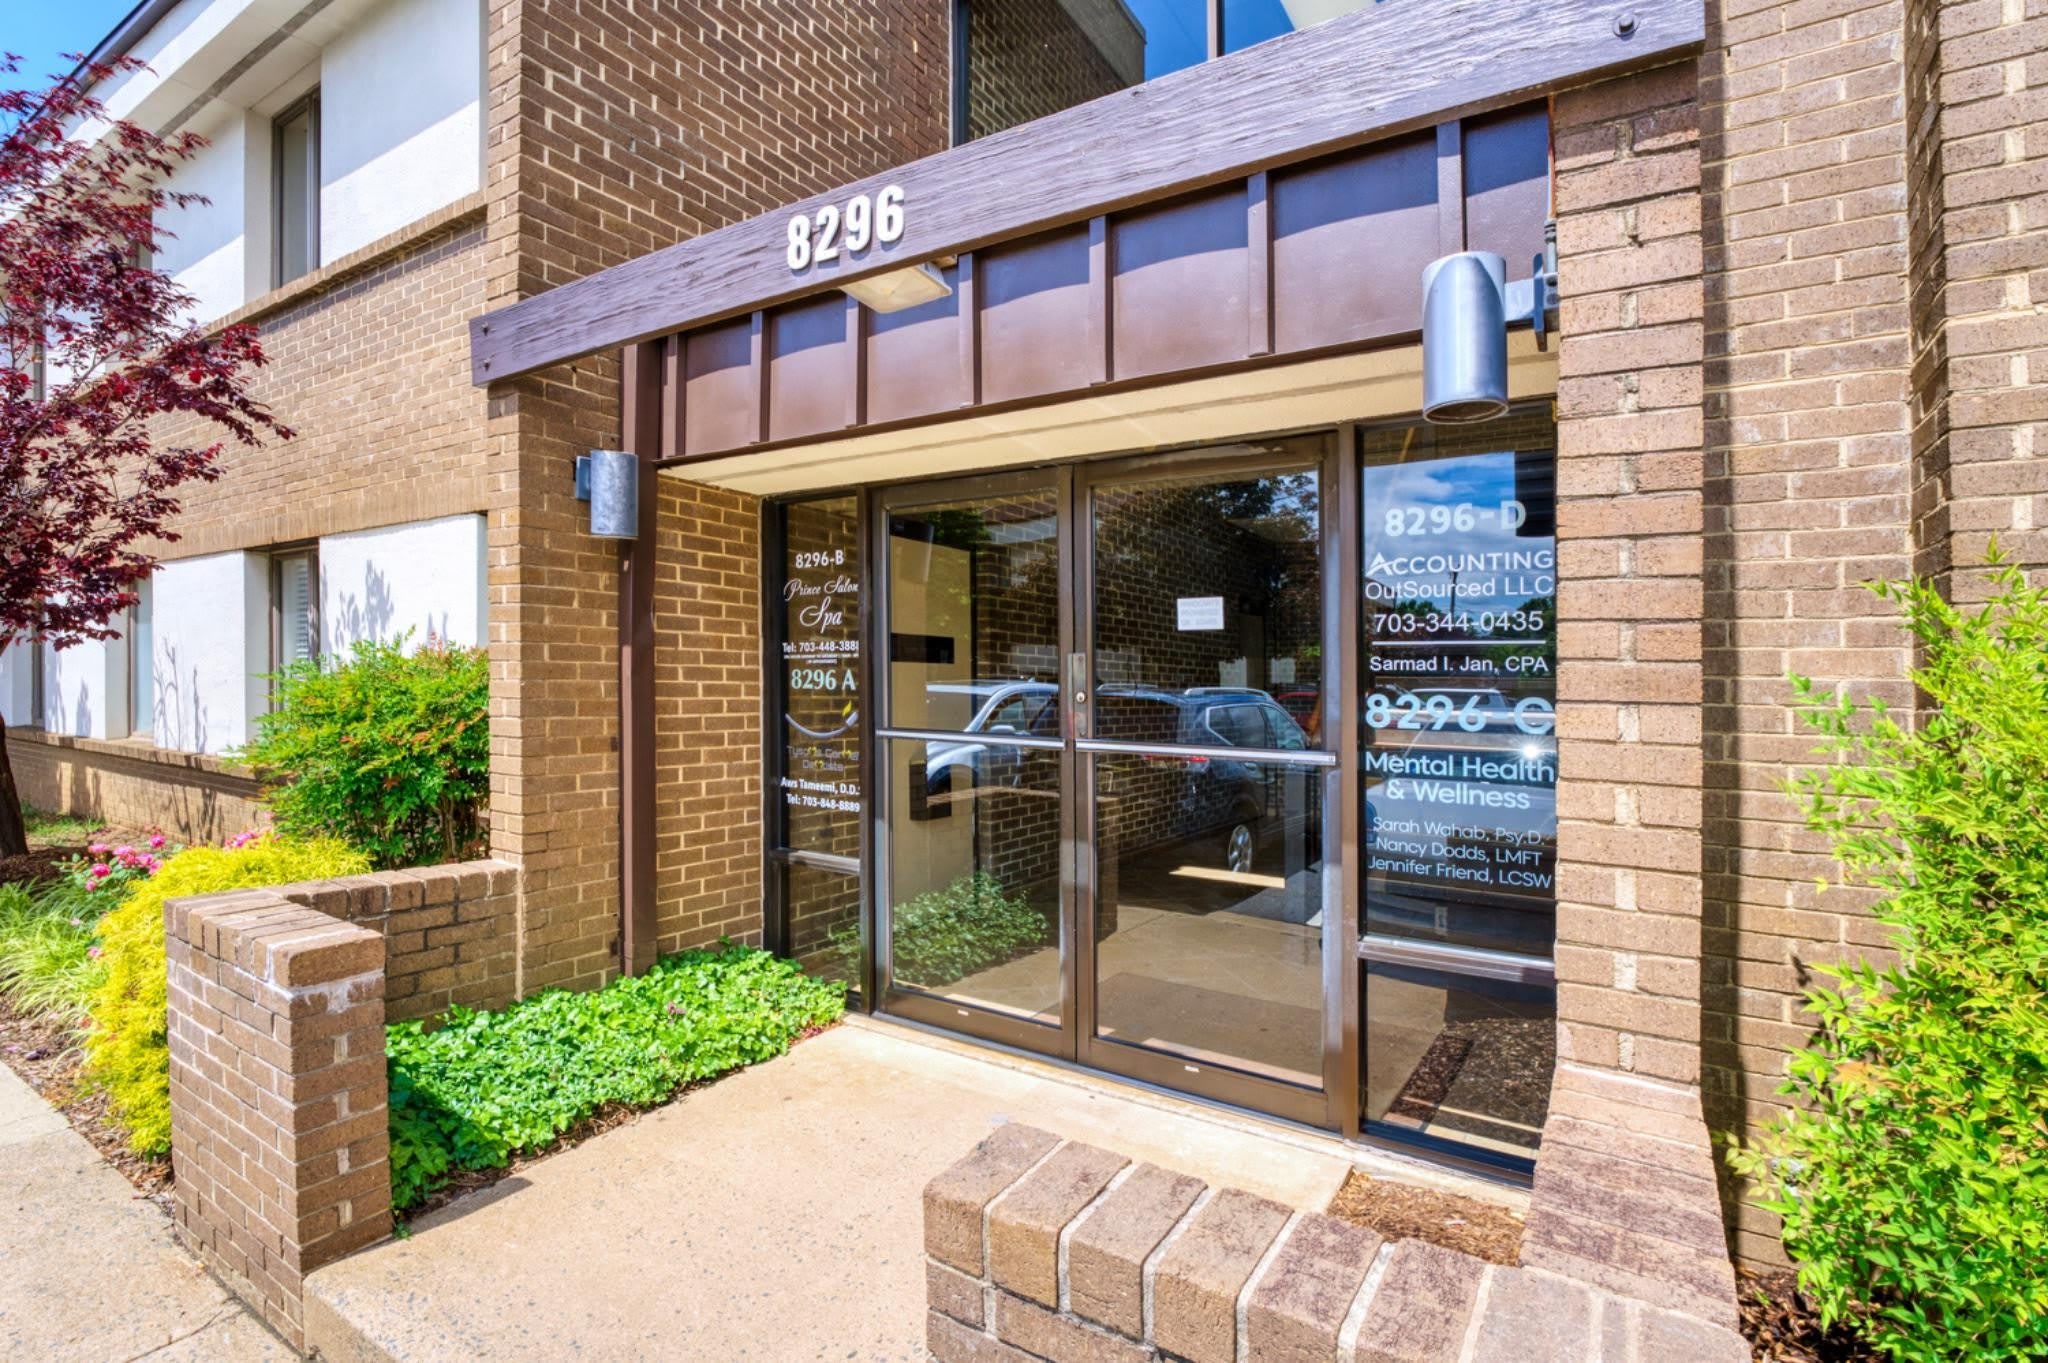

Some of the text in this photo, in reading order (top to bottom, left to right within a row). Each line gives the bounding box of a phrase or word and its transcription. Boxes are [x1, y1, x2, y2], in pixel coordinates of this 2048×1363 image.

[787, 185, 905, 270] 8296
[1384, 500, 1526, 537] 8296-D
[795, 549, 844, 569] 8296-B
[1365, 550, 1553, 577] ACCOUNTING
[783, 574, 858, 601] Prince Salon
[1365, 575, 1553, 600] OutSourced LLC
[800, 595, 842, 634] Spa
[1373, 610, 1543, 633] 703-344-0435
[782, 642, 796, 653] Tel:
[1369, 656, 1437, 672] Sarmad
[1459, 656, 1499, 675] Jan,
[1505, 656, 1549, 672] CPA
[791, 668, 857, 691] 8296 A
[1365, 752, 1554, 782] Mental Health
[786, 793, 801, 804] Tel:
[1386, 779, 1530, 809] & Wellness
[1373, 816, 1420, 833] Sarah
[1424, 821, 1489, 842] Wahab,
[1376, 836, 1542, 866] Nancy Dodds, LMFT
[1368, 856, 1551, 888] Jennifer Friend, LCSW
